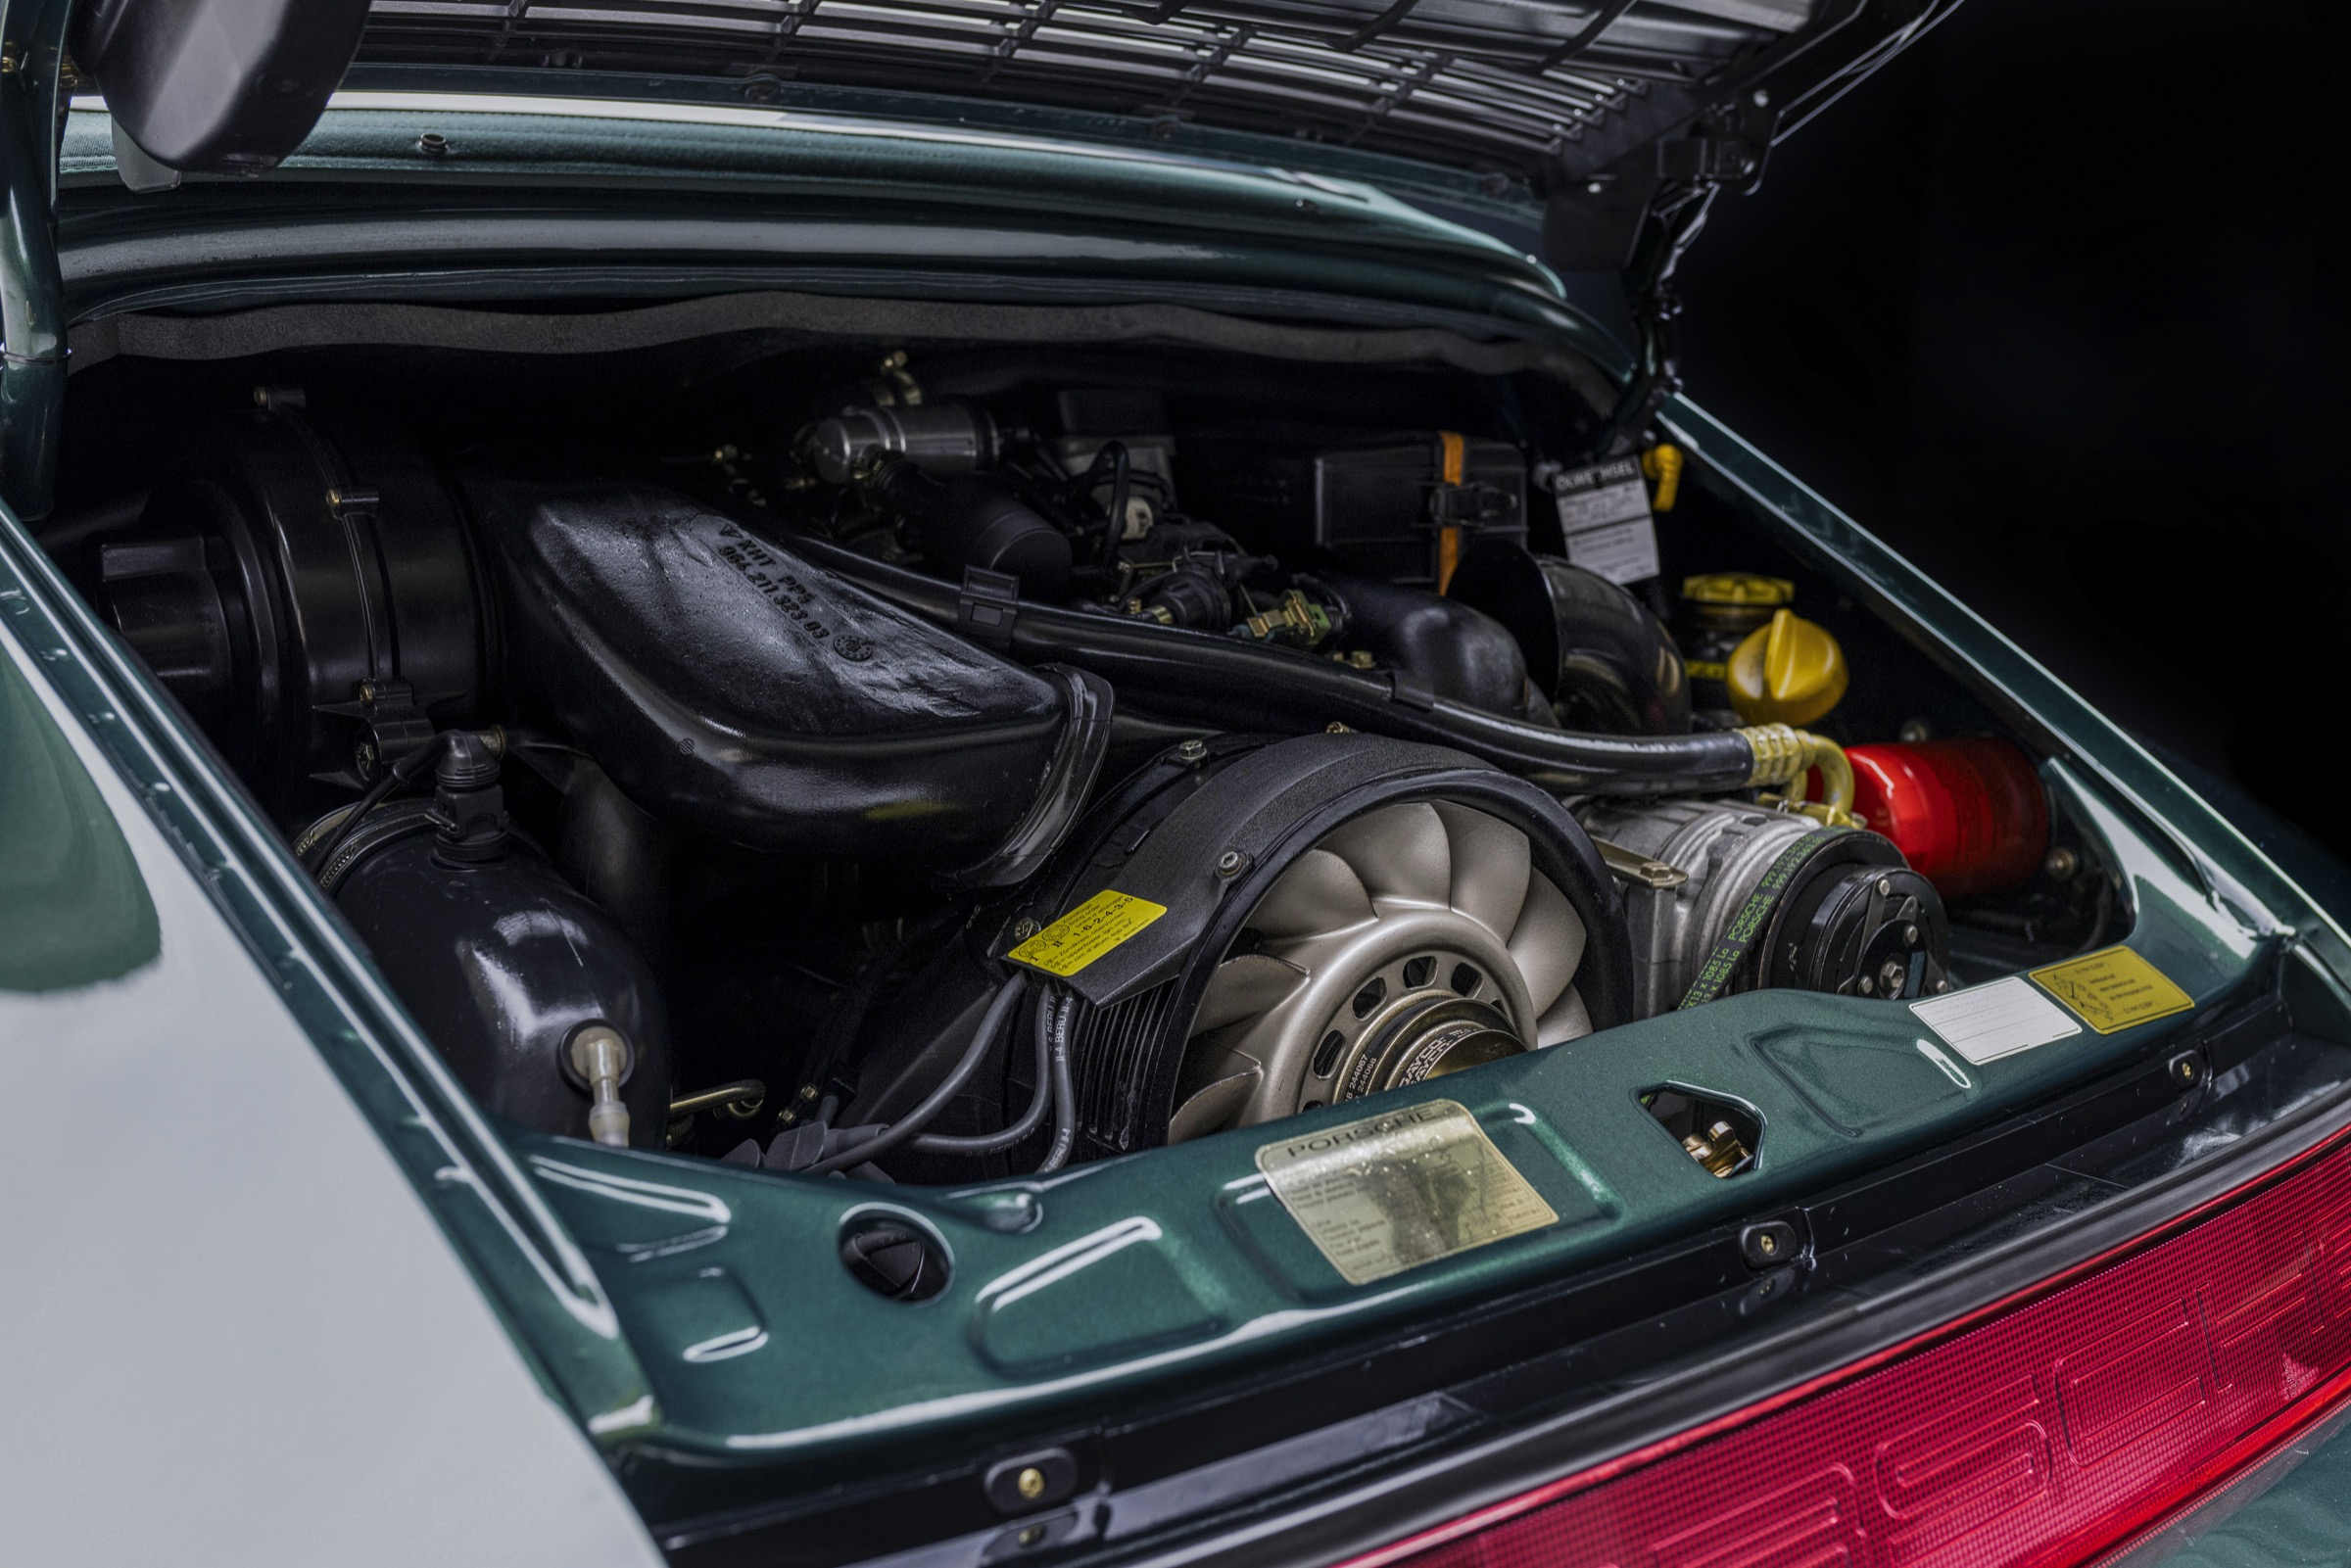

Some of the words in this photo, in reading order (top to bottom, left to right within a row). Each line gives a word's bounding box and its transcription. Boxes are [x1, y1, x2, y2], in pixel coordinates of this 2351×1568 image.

[1728, 892, 1763, 941] PORSCHE
[1739, 894, 1774, 943] PORSCHE
[1055, 1016, 1067, 1043] BERU
[1349, 1054, 1367, 1089] 244067
[1358, 1058, 1376, 1092] 244068
[1287, 1107, 1436, 1158] PORSCHE
